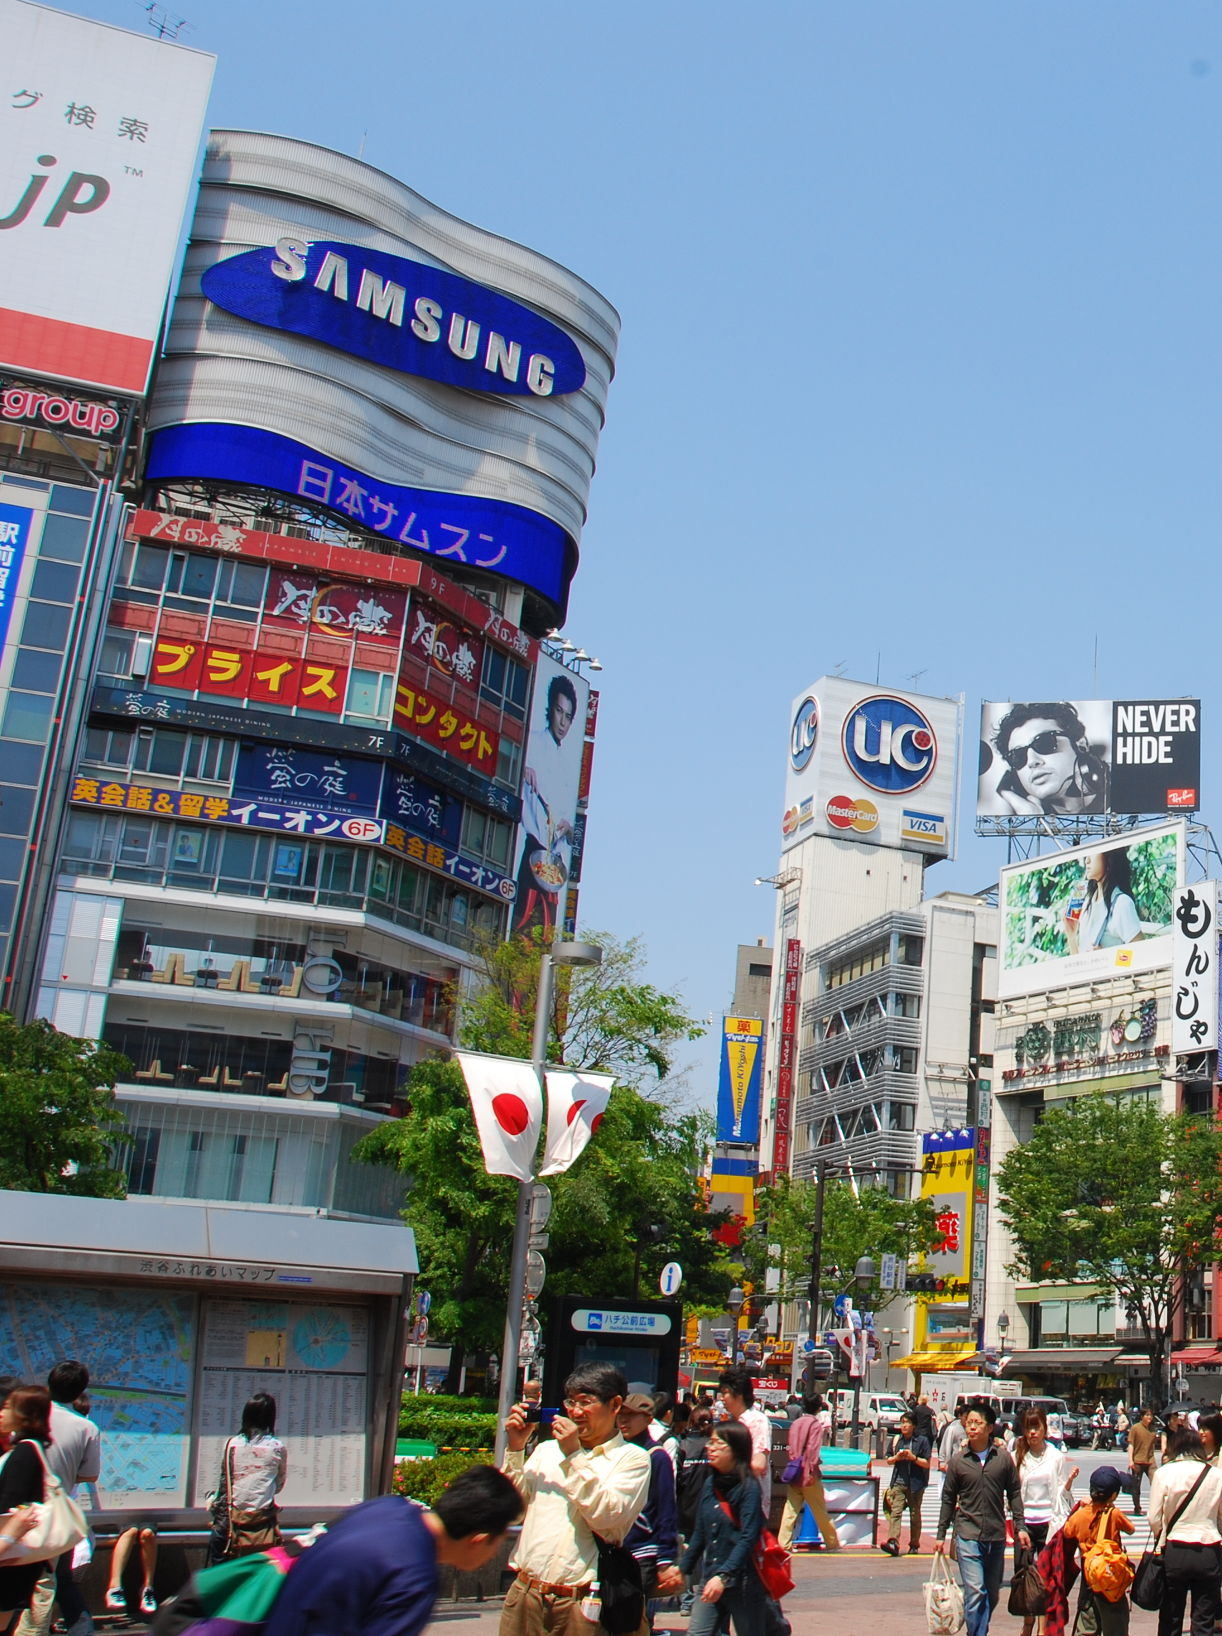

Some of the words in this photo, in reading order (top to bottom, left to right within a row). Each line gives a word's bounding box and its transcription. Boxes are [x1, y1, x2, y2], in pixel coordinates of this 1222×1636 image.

[270, 236, 555, 397] SAMSUNG
[2, 388, 120, 435] group
[297, 459, 508, 567] 日本サムスン
[431, 577, 446, 595] 9F
[155, 641, 339, 699] プライス
[394, 684, 493, 761] コンタクト
[1117, 703, 1196, 734] NEVER
[368, 735, 384, 748] 7F
[400, 742, 411, 757] 7F
[1116, 735, 1174, 765] HIDE
[827, 804, 878, 823] MasterCard
[347, 821, 376, 837] 6F
[908, 818, 937, 834] VISA
[501, 881, 515, 895] 6F
[1176, 889, 1212, 1044] もんじゃ
[736, 1019, 751, 1033] 薬
[140, 1260, 276, 1281] 渋谷ふれあいマップ
[605, 1314, 656, 1327] ハチ公前広場
